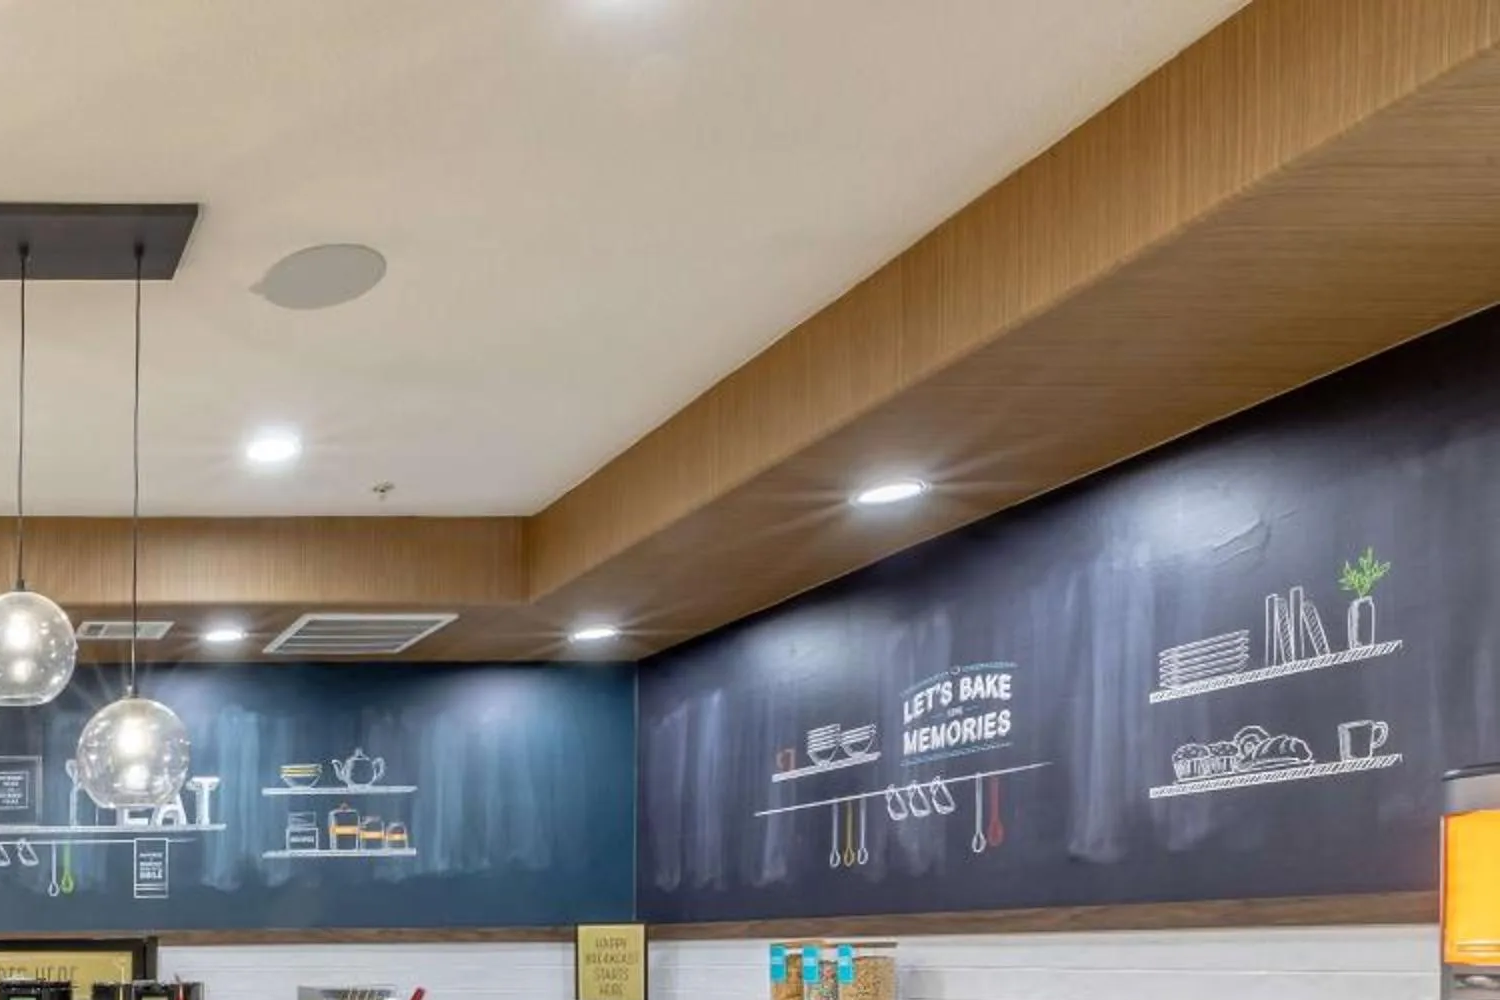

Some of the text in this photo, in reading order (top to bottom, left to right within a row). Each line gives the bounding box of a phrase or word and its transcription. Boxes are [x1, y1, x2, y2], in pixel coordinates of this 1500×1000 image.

[903, 673, 1013, 725] LET'S BAKE
[903, 709, 1012, 756] MEMORIES
